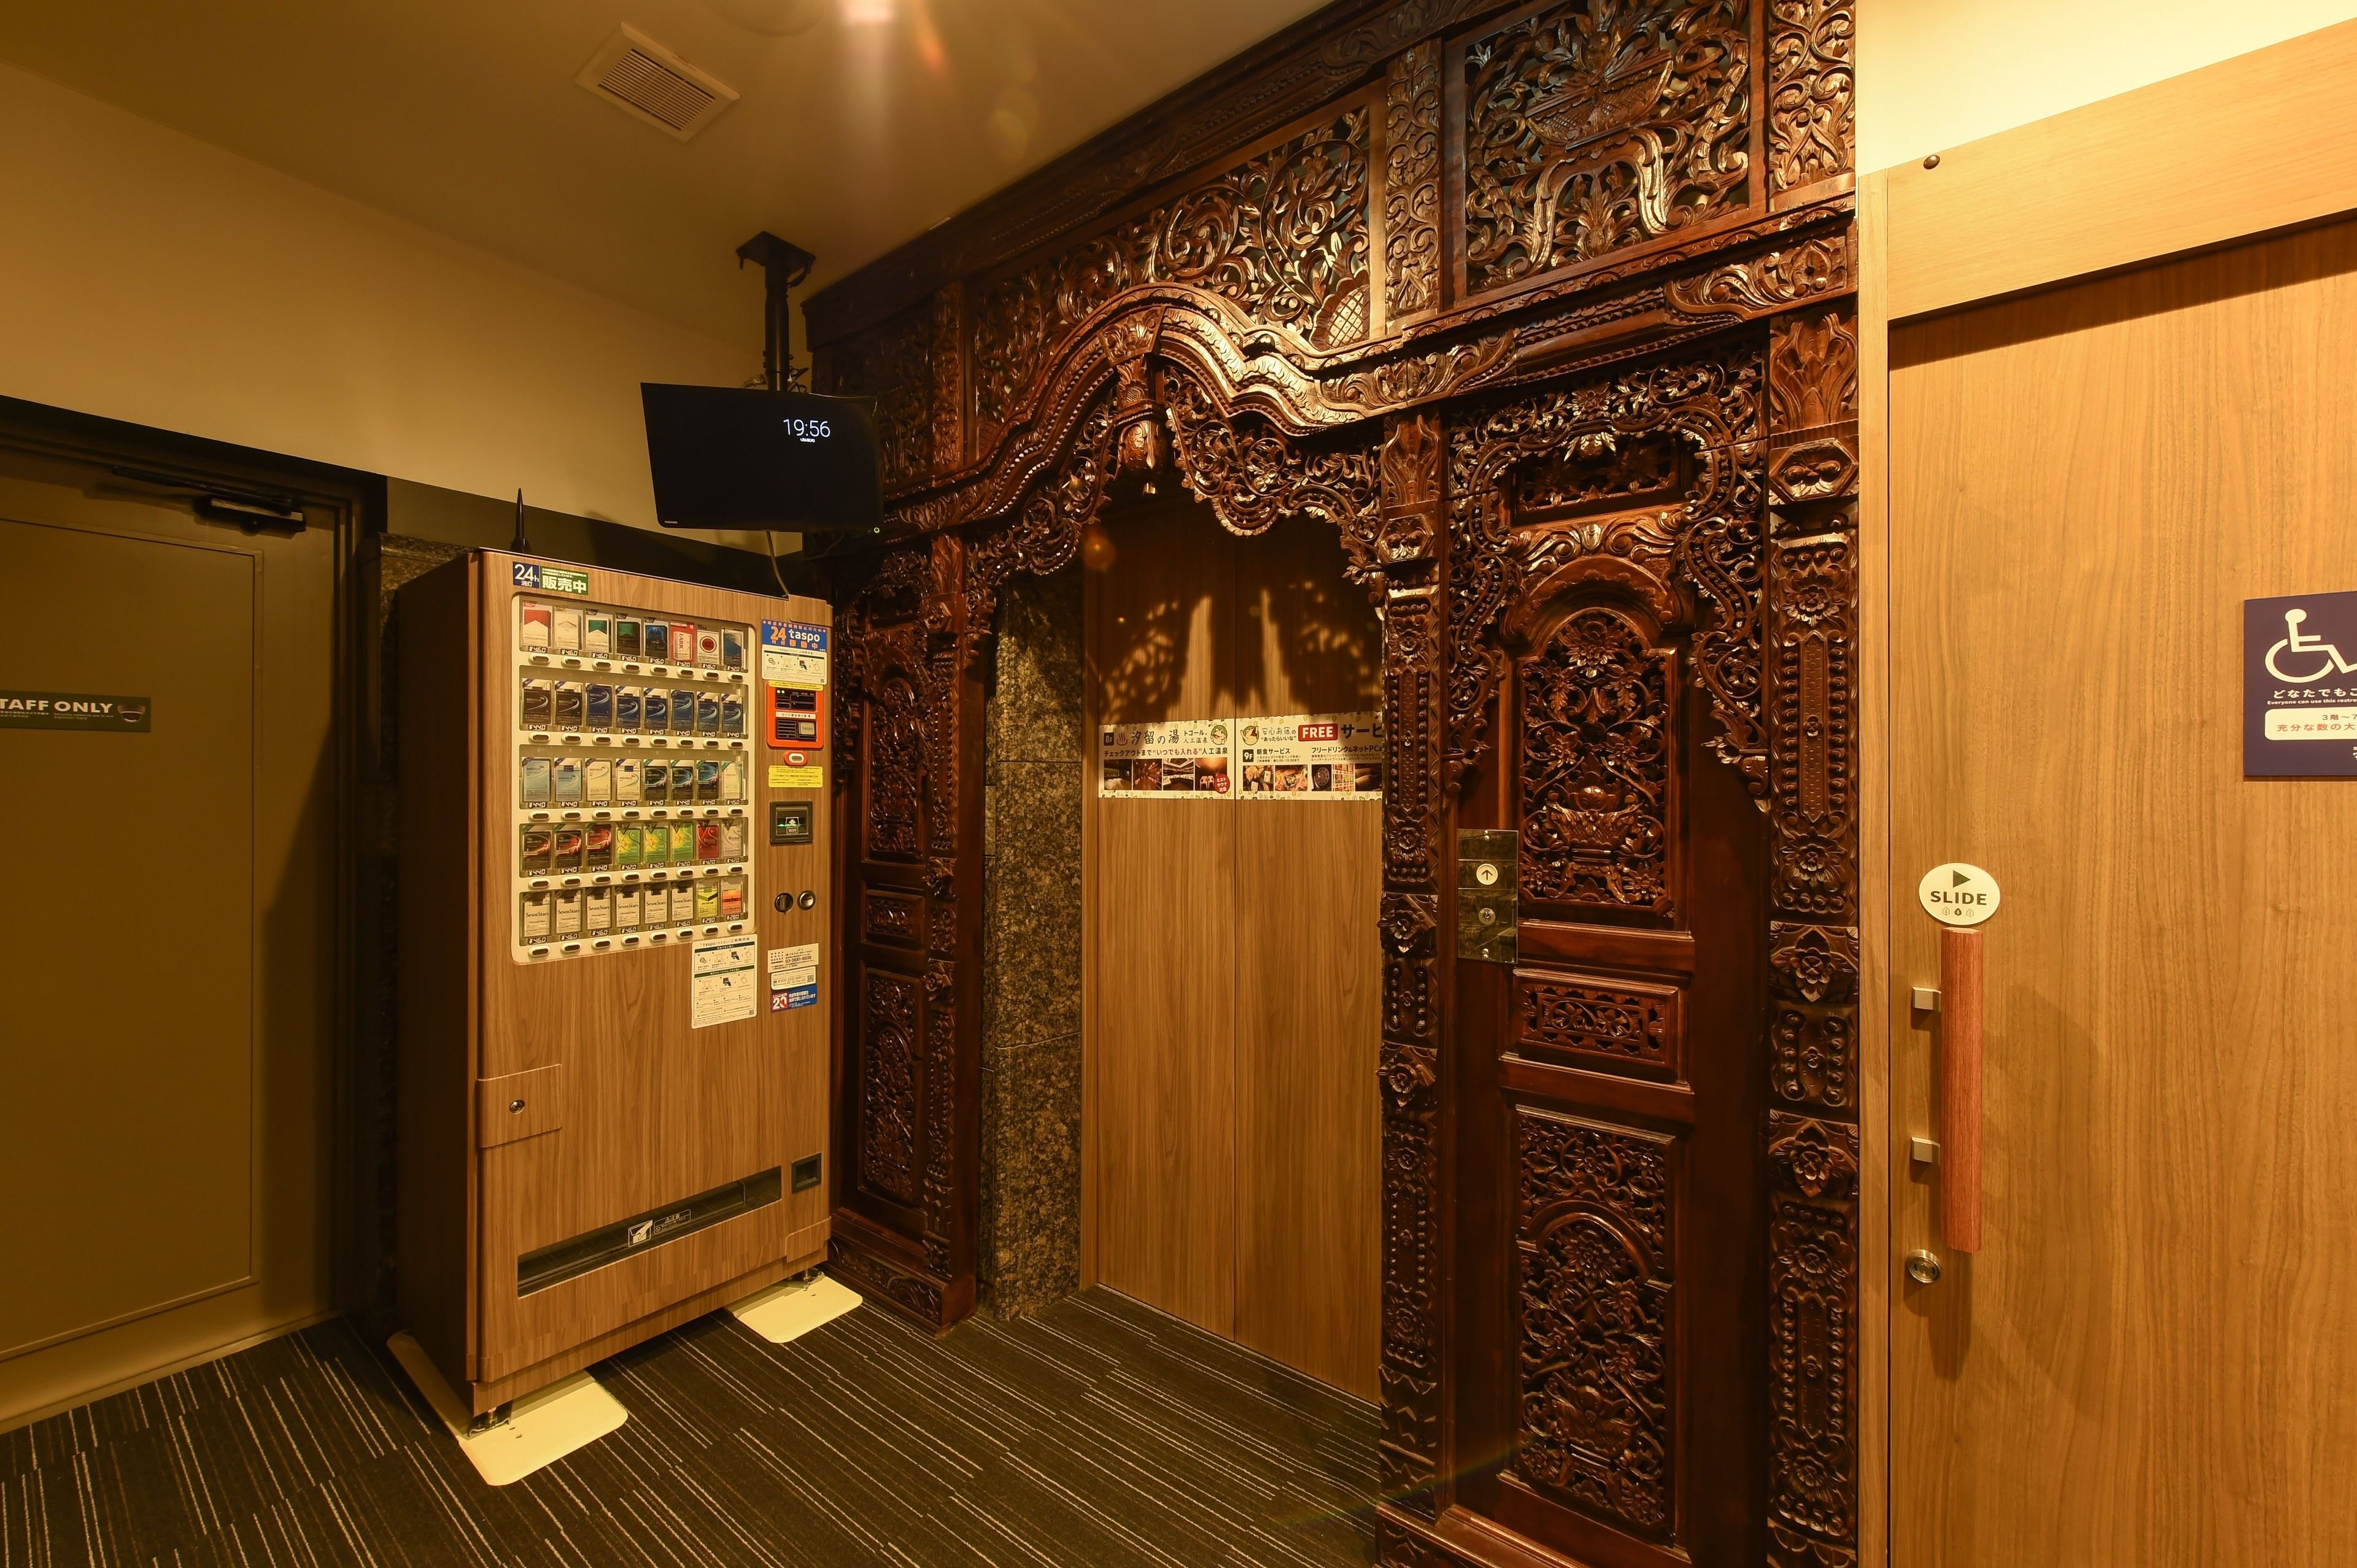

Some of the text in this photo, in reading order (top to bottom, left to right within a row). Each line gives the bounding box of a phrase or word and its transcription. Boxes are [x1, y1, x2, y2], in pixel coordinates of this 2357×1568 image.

[783, 419, 830, 438] 19:56
[542, 575, 587, 593] 販売中
[770, 626, 820, 643] 24 taspo
[54, 701, 113, 713] ONLY
[1131, 730, 1179, 745] 汐留の湯
[1302, 726, 1333, 739] FREE
[1930, 890, 1987, 905] SLIDE
